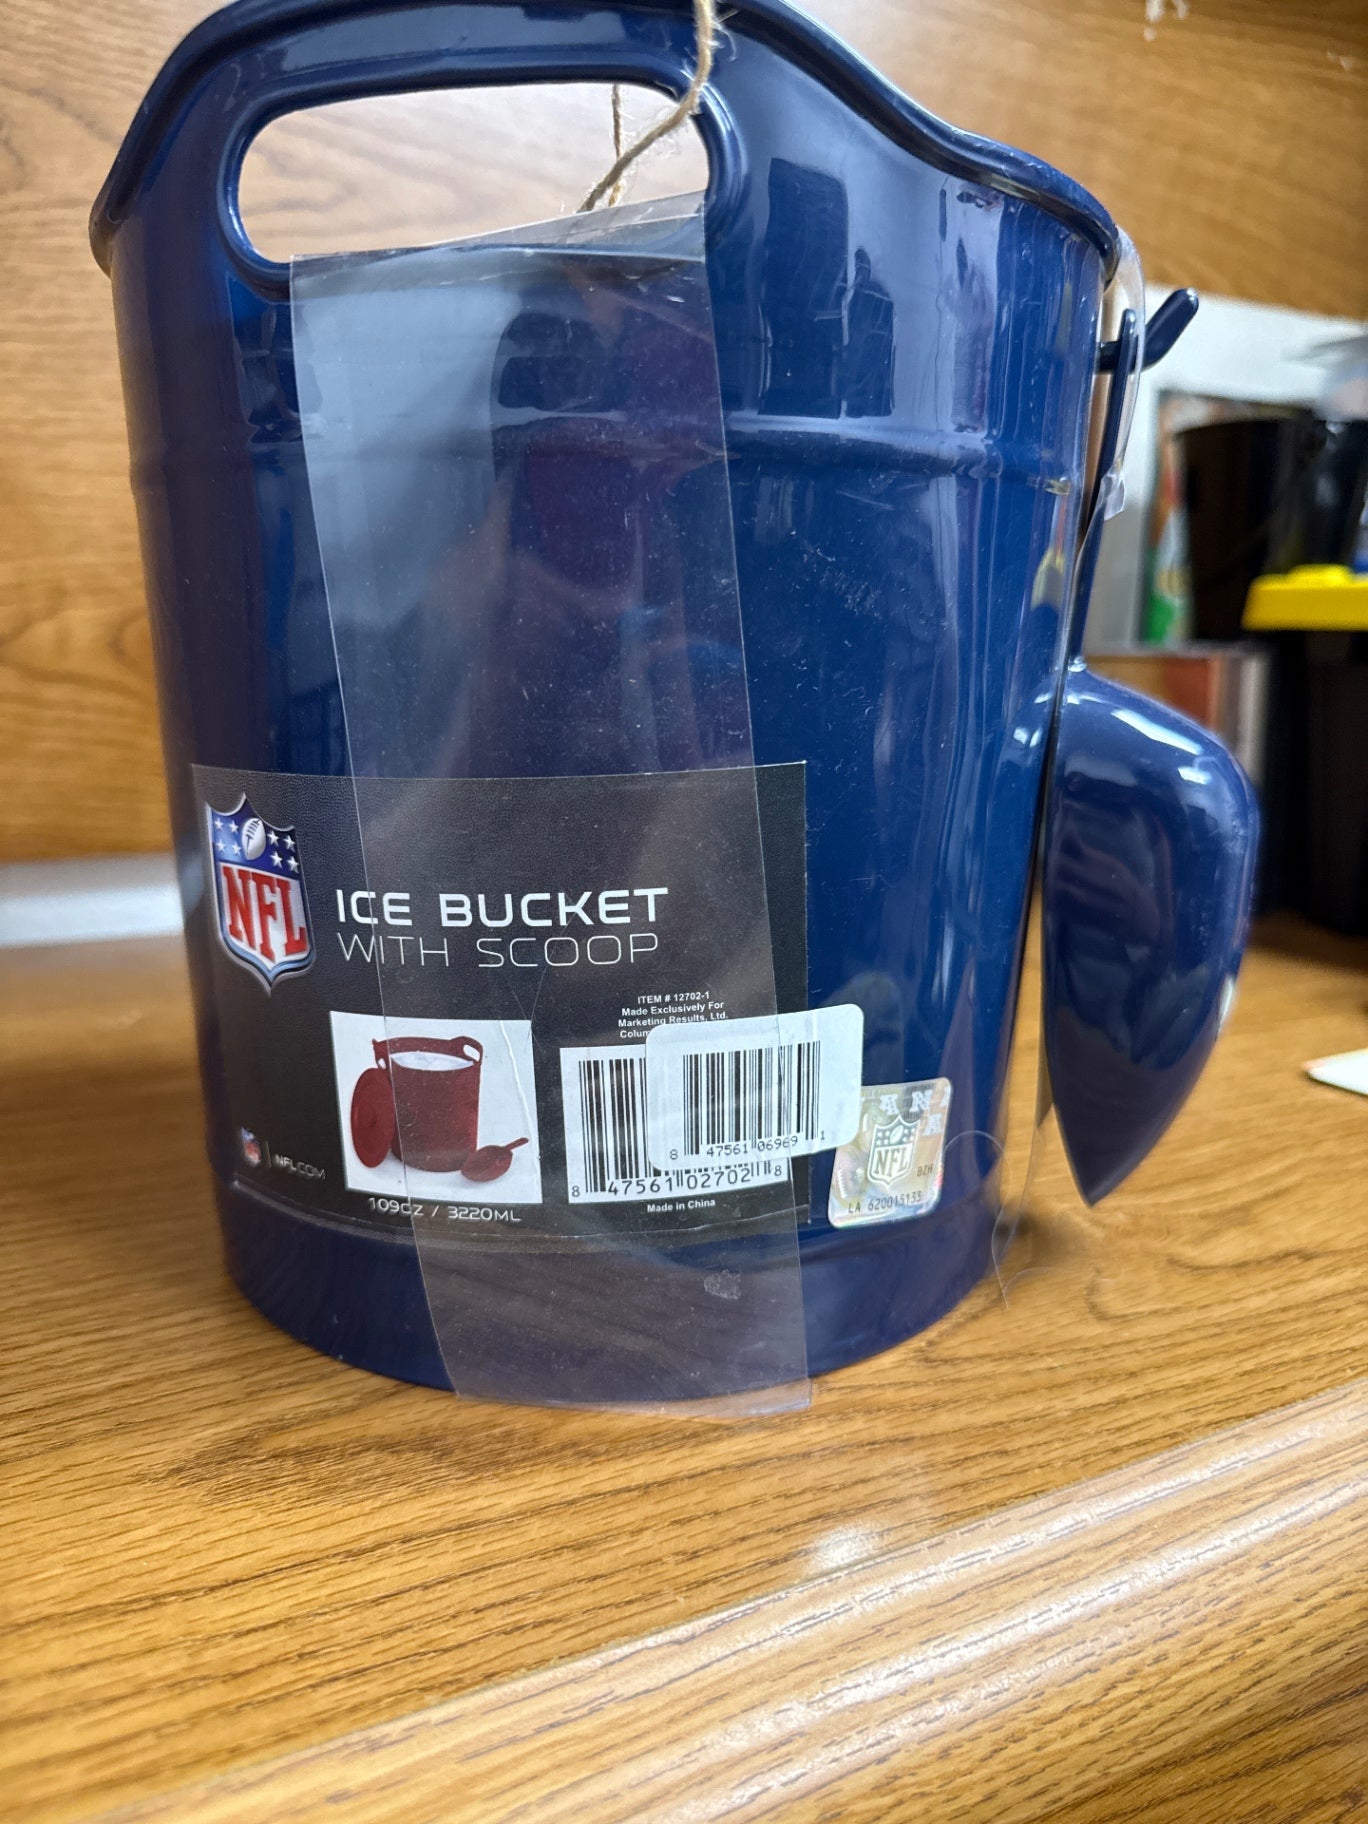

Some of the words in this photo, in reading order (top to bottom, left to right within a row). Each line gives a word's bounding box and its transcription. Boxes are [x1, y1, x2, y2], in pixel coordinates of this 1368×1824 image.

[222, 865, 307, 962] NFL
[336, 889, 413, 926] ICE
[439, 887, 669, 927] BUCKET
[337, 932, 450, 967] WITH
[476, 932, 659, 968] SCOOP
[621, 1007, 648, 1016] Made
[651, 1002, 706, 1015] Exclusively
[708, 1000, 725, 1010] For
[637, 995, 662, 1005] ITEM
[665, 994, 671, 1003] #
[673, 991, 710, 1002] 12702-1
[618, 1017, 666, 1028] Marketing
[710, 1011, 729, 1020] Ltd.
[619, 1029, 650, 1039] Colum
[670, 1149, 678, 1160] 8
[706, 1143, 748, 1157] 47561
[820, 1130, 826, 1140] 1
[274, 1153, 326, 1180] NFLCOM
[873, 1146, 909, 1178] NFL
[571, 1185, 581, 1197] 8
[608, 1177, 673, 1195] 47561
[687, 1168, 751, 1190] 02702
[774, 1165, 782, 1176] 8
[448, 1205, 522, 1222] 3220ML
[647, 1203, 673, 1212] Made
[676, 1202, 685, 1210] in
[687, 1200, 716, 1209] China
[848, 1201, 861, 1214] LA
